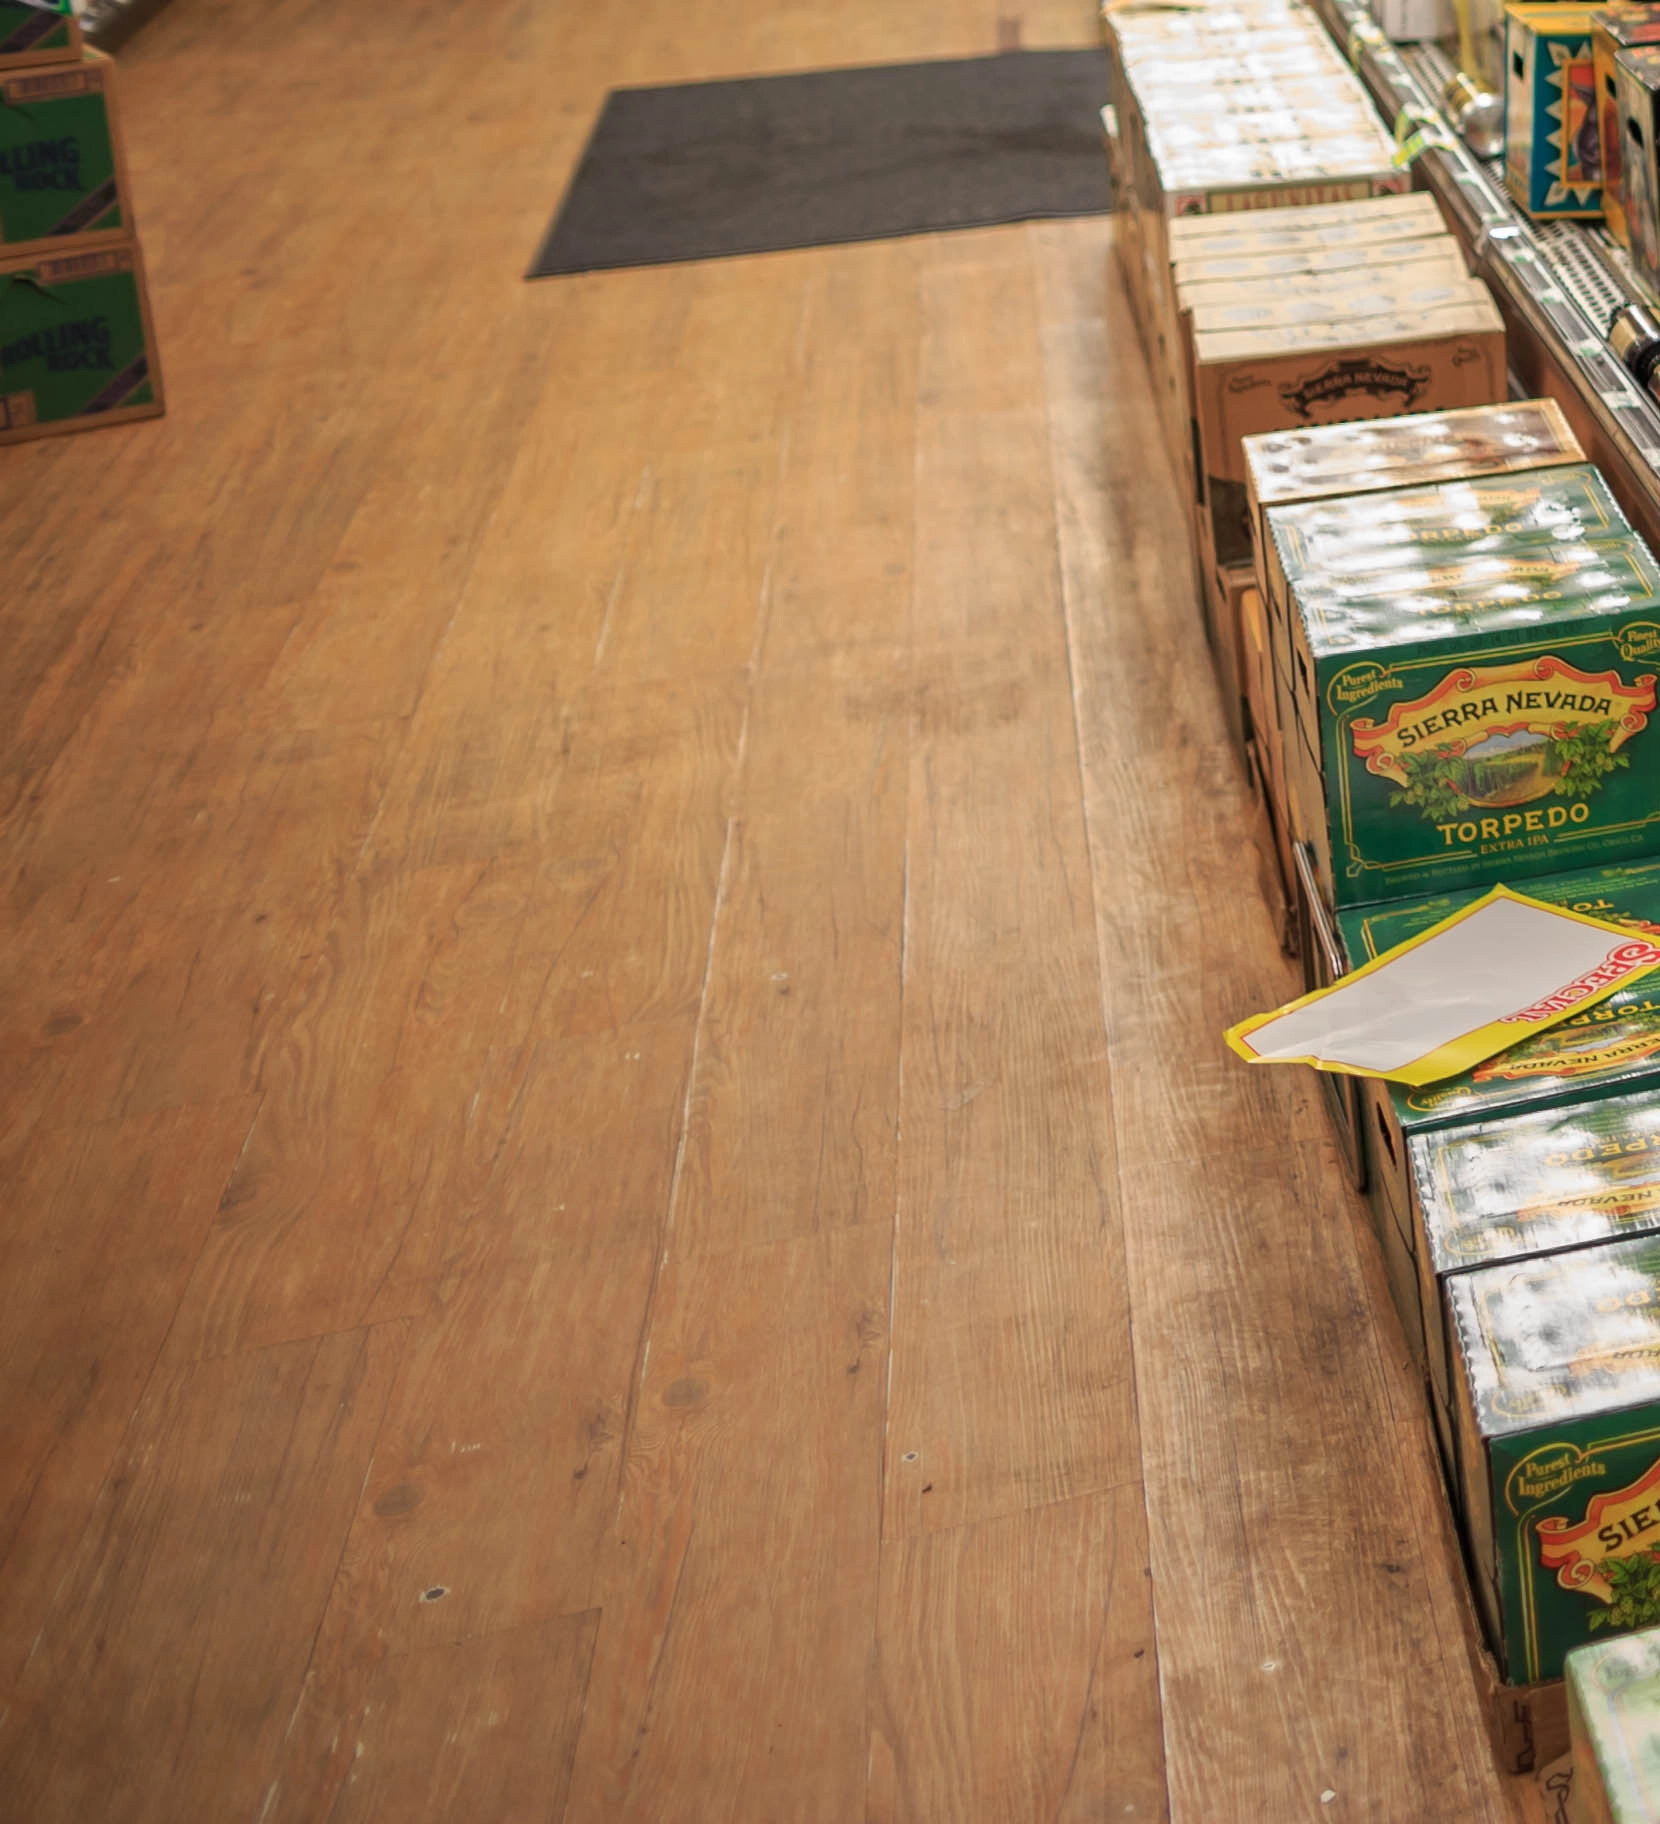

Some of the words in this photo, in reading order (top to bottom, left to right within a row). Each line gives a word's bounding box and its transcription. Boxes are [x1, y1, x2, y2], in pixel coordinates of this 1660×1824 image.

[1627, 628, 1658, 645] Finest
[1335, 676, 1404, 701] Ingredients
[1340, 668, 1377, 686] Purest
[1397, 697, 1499, 748] SIERRA
[1505, 691, 1612, 717] NEVADA
[1436, 802, 1591, 845] TORPEDO
[1479, 835, 1524, 856] EXTRA
[1526, 833, 1549, 849] IPA
[1507, 1051, 1603, 1074] NEVADA
[1557, 1186, 1659, 1210] NEVADA
[1524, 1452, 1572, 1477] Purest
[1516, 1461, 1606, 1498] Ingredients
